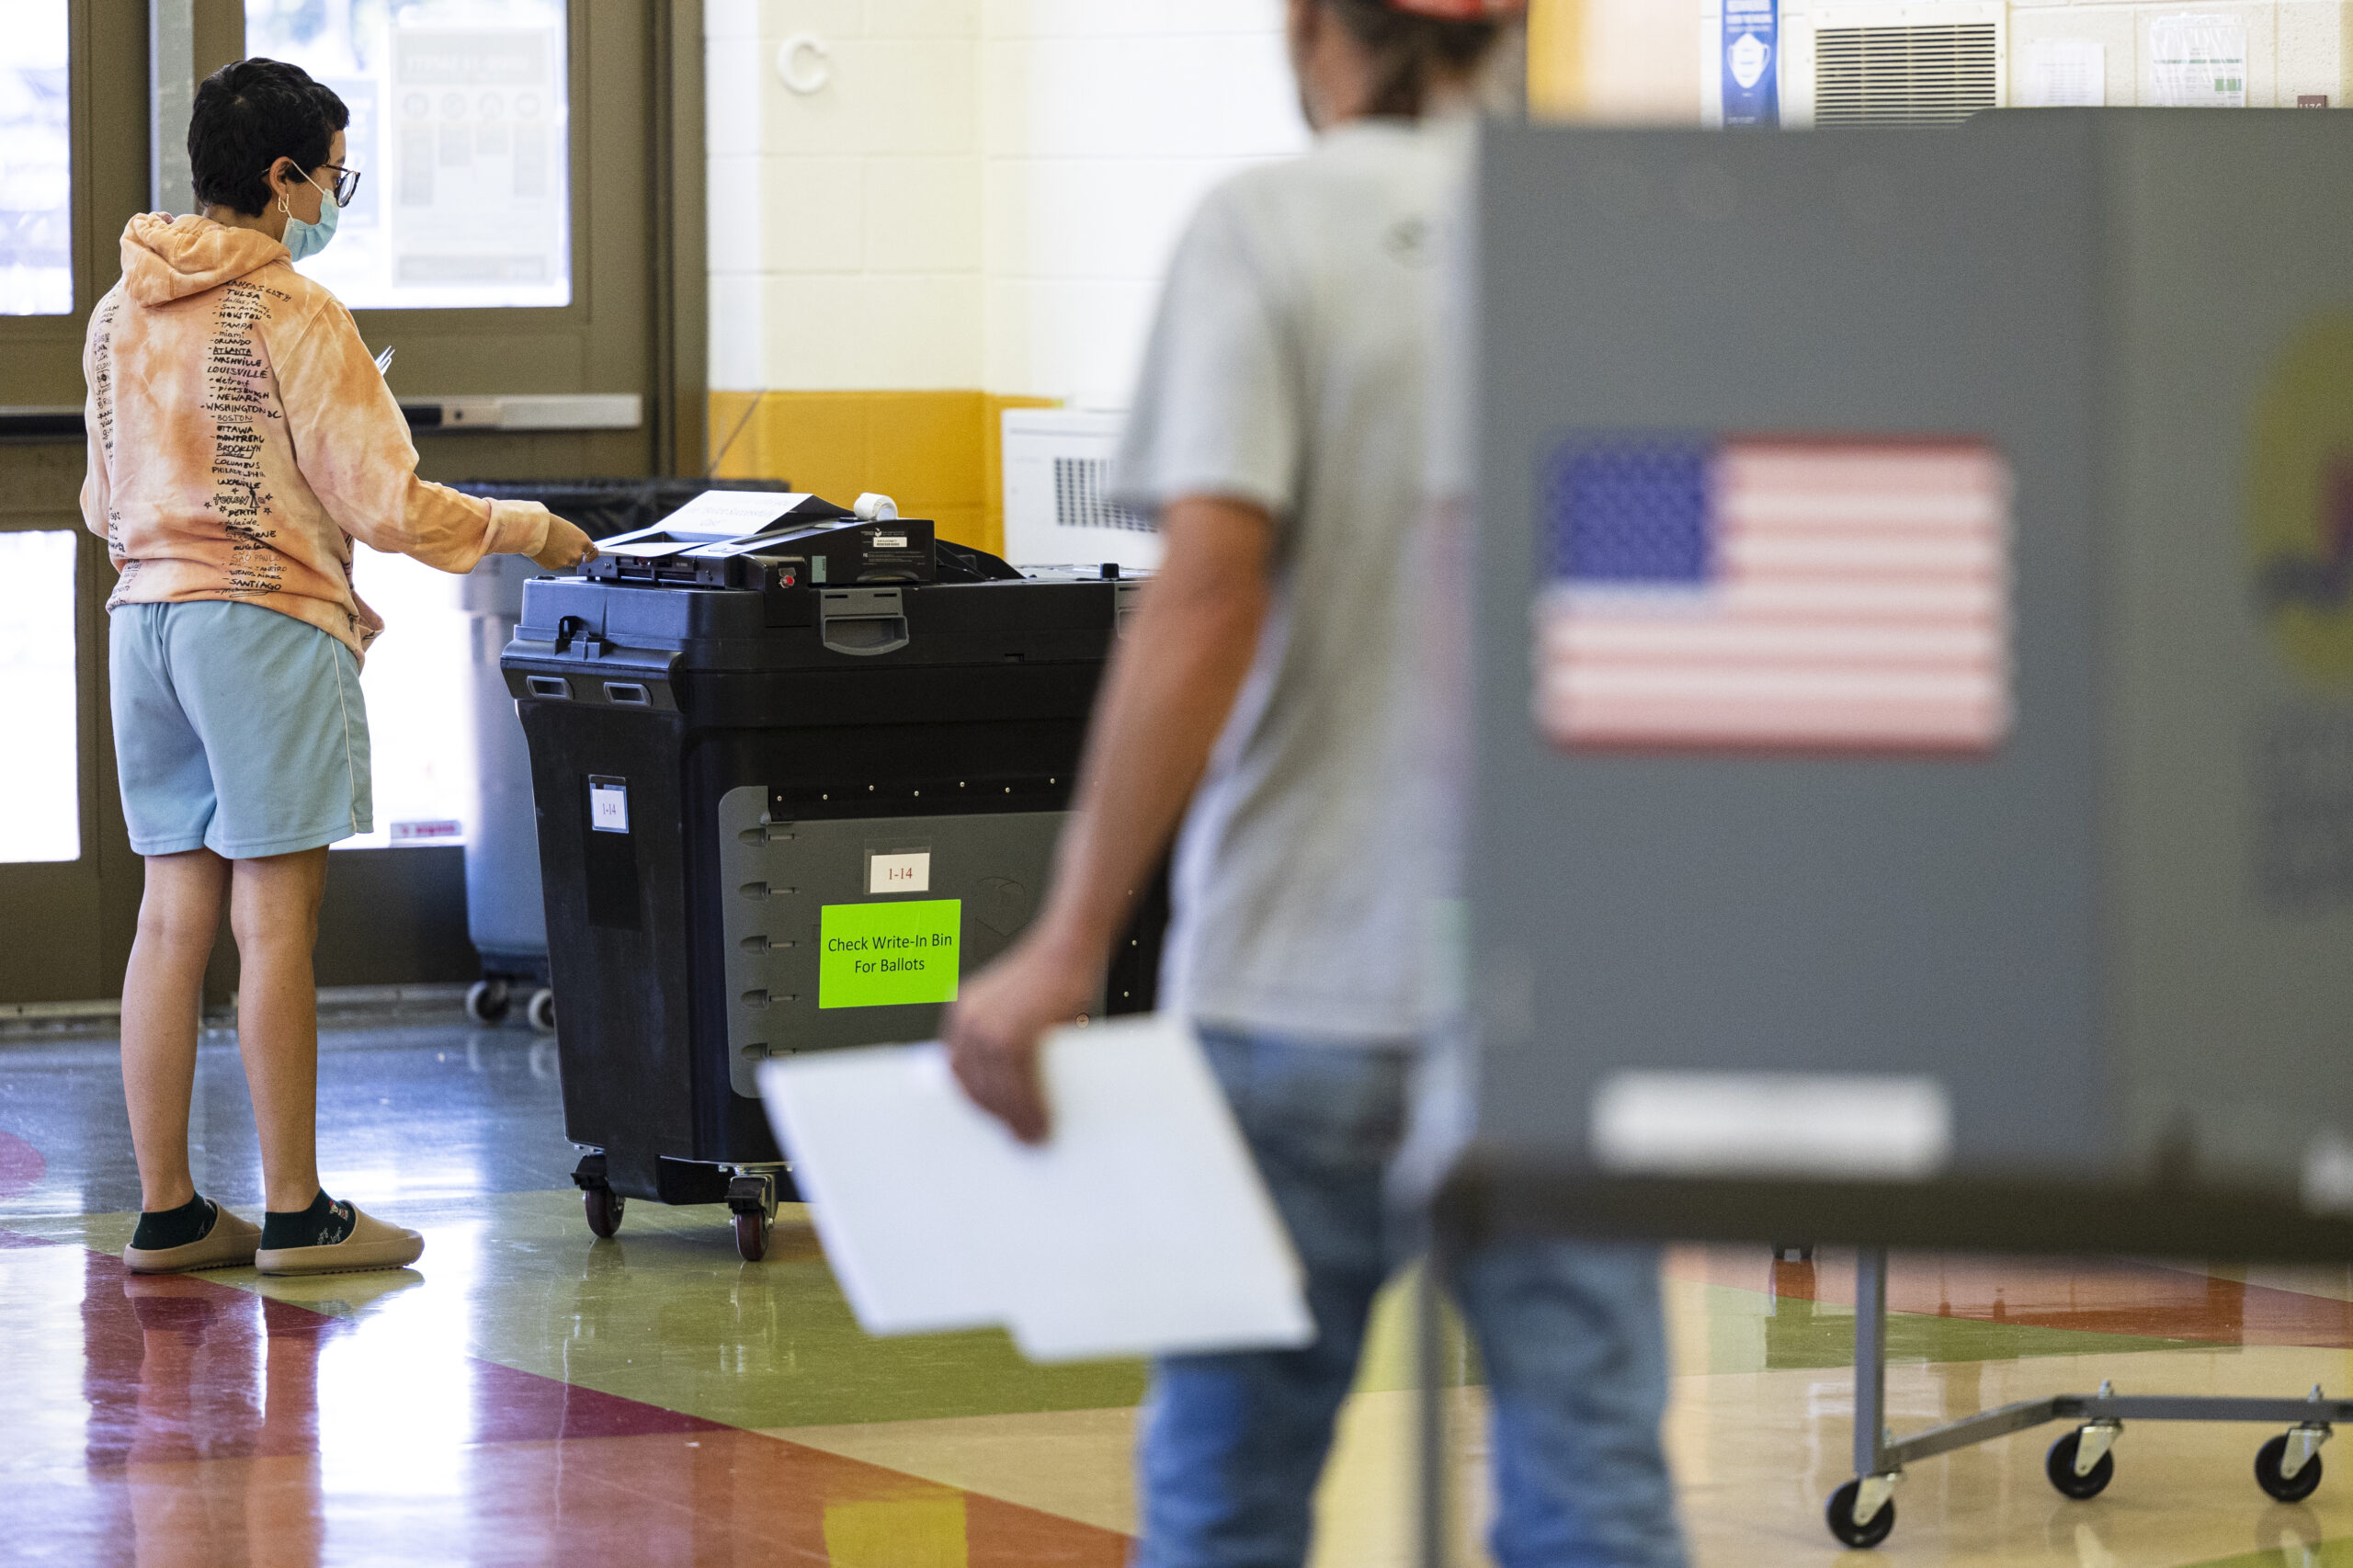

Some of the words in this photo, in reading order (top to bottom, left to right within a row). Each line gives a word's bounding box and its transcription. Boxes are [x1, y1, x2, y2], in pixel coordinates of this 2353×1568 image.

[226, 289, 261, 301] TULSA
[219, 312, 262, 320] HOUSTON
[221, 322, 253, 331] TAMPA
[219, 329, 244, 338] miami
[212, 347, 253, 356] ATLANTA
[215, 377, 250, 387] detroit
[217, 393, 262, 404] NEWARK
[206, 403, 266, 414] WASHINGTON
[217, 426, 253, 434] OTTAWA
[216, 434, 265, 443] MONTREAL
[216, 442, 261, 454] BROOKLYN
[214, 459, 260, 470] COLUMBUS
[889, 868, 913, 881] 1-14
[828, 937, 869, 952] Check
[872, 934, 927, 949] Write-In
[932, 933, 952, 947] Bin
[855, 960, 876, 973] For
[881, 958, 926, 972] Ballots
